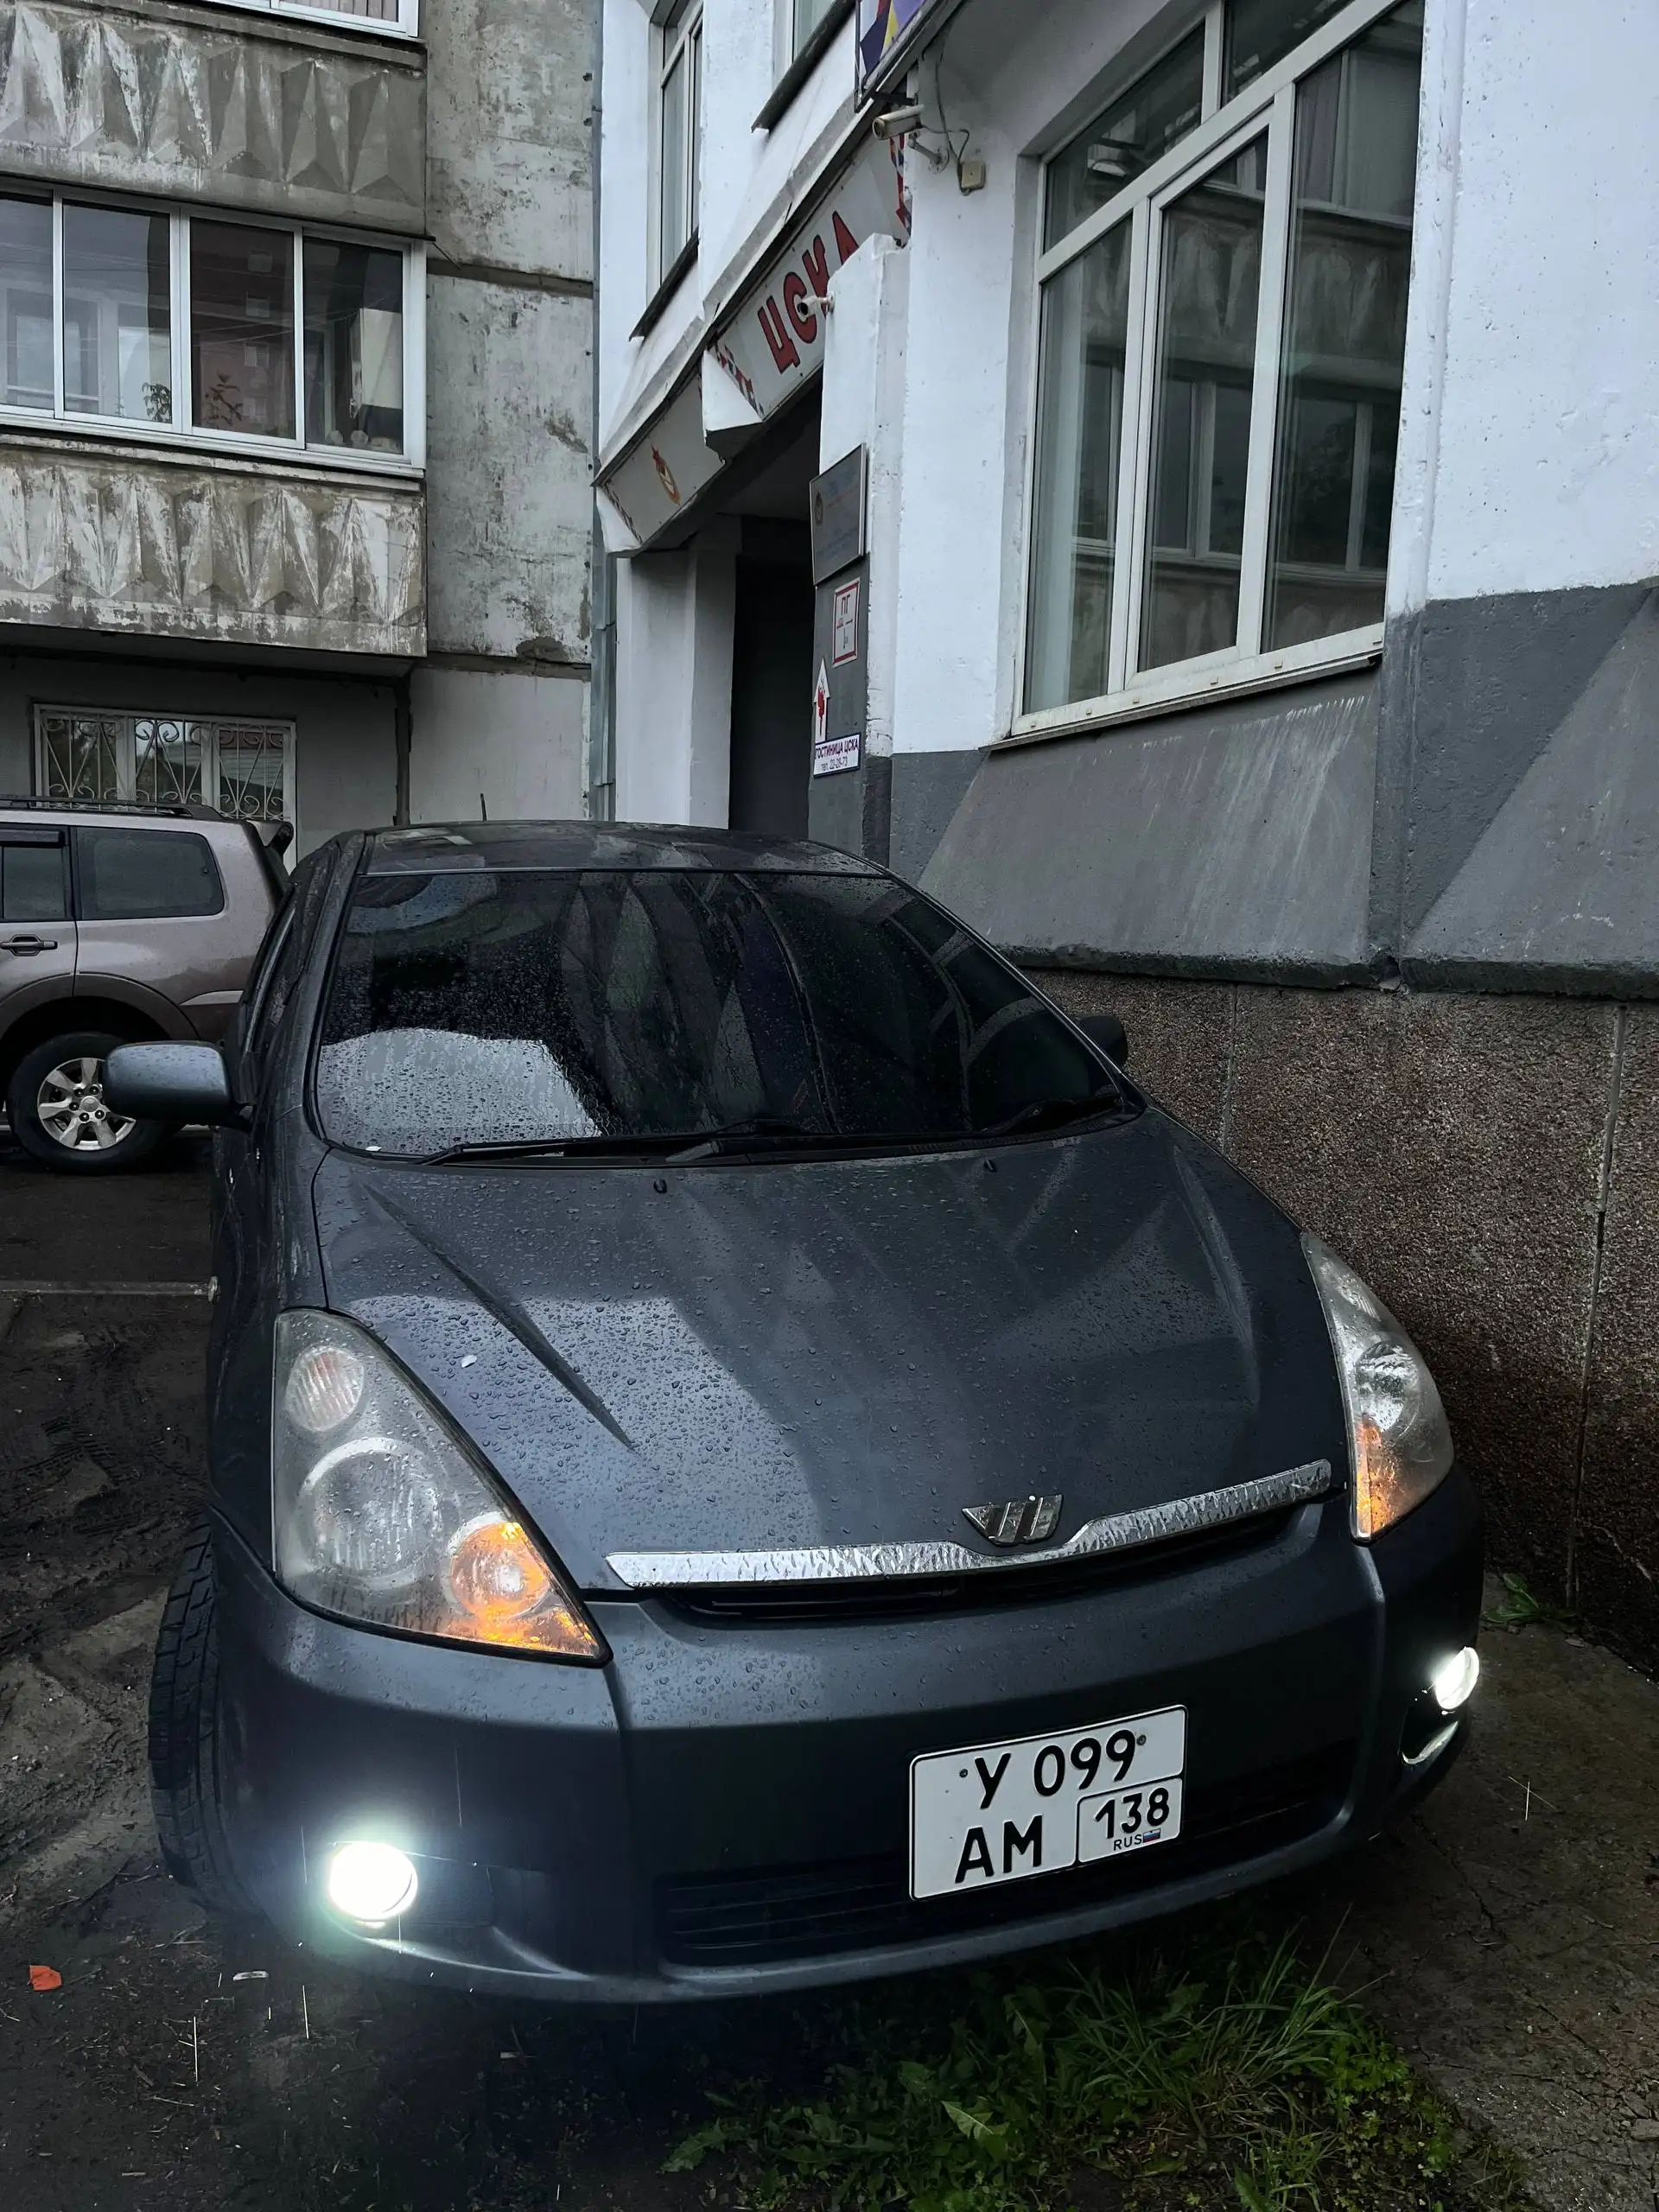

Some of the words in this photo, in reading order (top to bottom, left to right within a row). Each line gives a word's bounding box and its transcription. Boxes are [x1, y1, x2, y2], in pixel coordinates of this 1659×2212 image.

[1033, 1729, 1135, 1796] 099
[1095, 1787, 1169, 1839] 138
[1113, 1834, 1142, 1852] RUS
